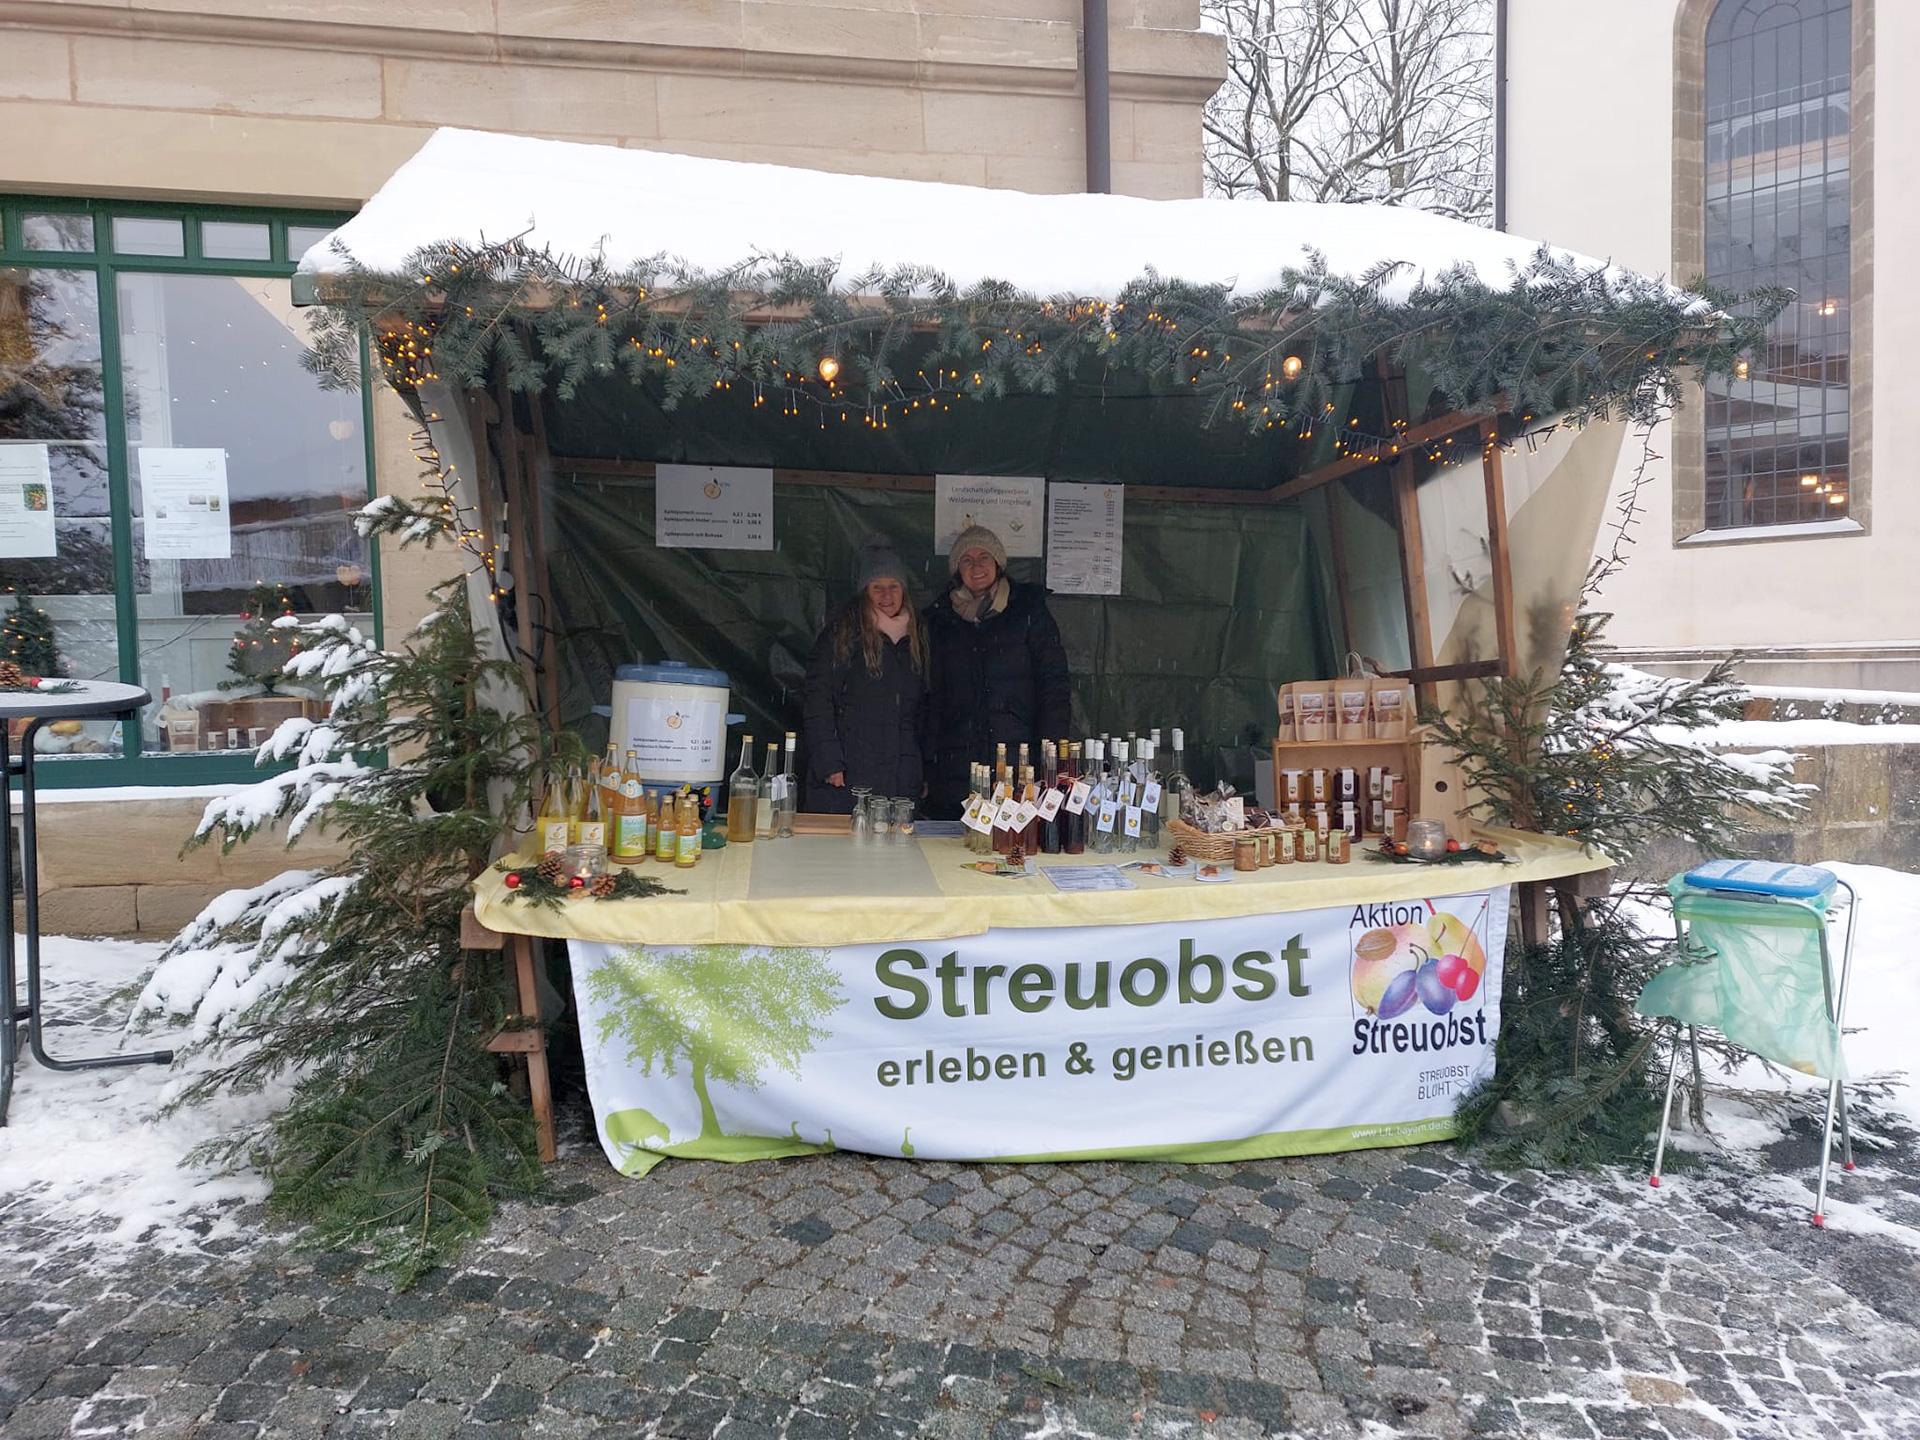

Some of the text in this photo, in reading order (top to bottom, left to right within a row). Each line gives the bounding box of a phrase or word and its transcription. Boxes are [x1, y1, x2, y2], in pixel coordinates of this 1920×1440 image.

[1350, 904, 1423, 929] Aktion
[874, 933, 1311, 1020] Streuobst
[1352, 1008, 1487, 1056] Streuobst
[877, 1030, 1314, 1087] erleben & genießen
[1419, 1065, 1470, 1083] STREUOBST
